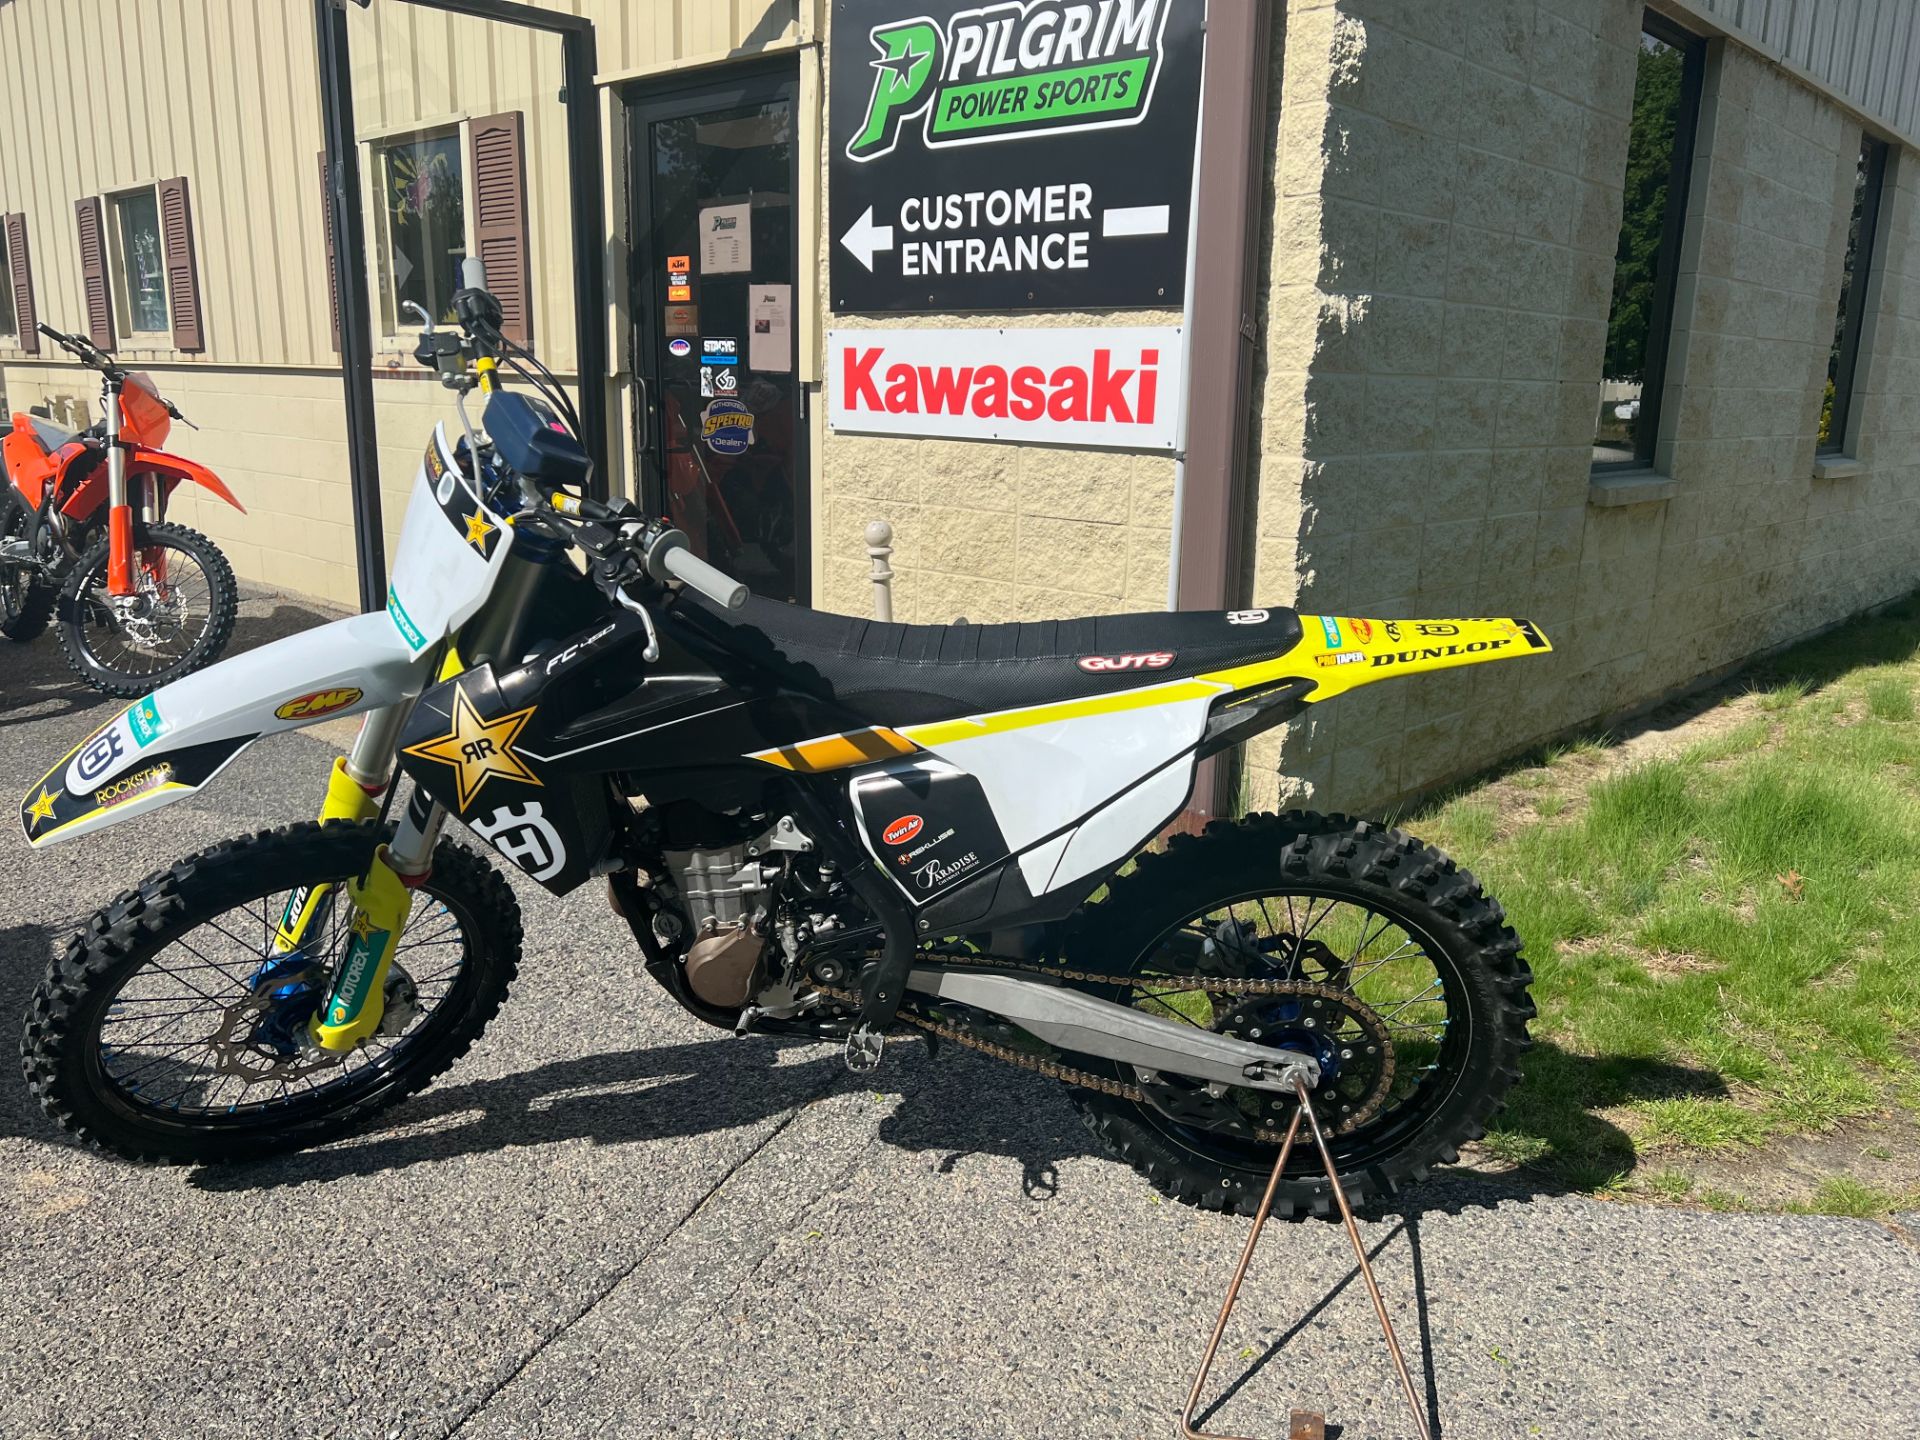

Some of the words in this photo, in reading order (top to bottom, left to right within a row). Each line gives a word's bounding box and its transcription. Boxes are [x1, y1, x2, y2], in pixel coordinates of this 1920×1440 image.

[948, 0, 1157, 81] PILGRIM
[946, 86, 1028, 121] POWER
[1034, 70, 1132, 109] SPORTS
[900, 183, 1093, 232] CUSTOMER
[902, 232, 1089, 276] ENTRANCE
[843, 347, 1159, 425] Kawasaki
[715, 438, 743, 446] Dealer
[546, 644, 579, 675] FC
[1078, 652, 1174, 671] GUTS
[1371, 639, 1511, 667] DUNLOP
[279, 688, 360, 718] FMF
[887, 827, 908, 842] Twin
[908, 818, 921, 831] Air
[910, 851, 978, 889] PARADISE
[337, 947, 371, 1008] MOTOREX
